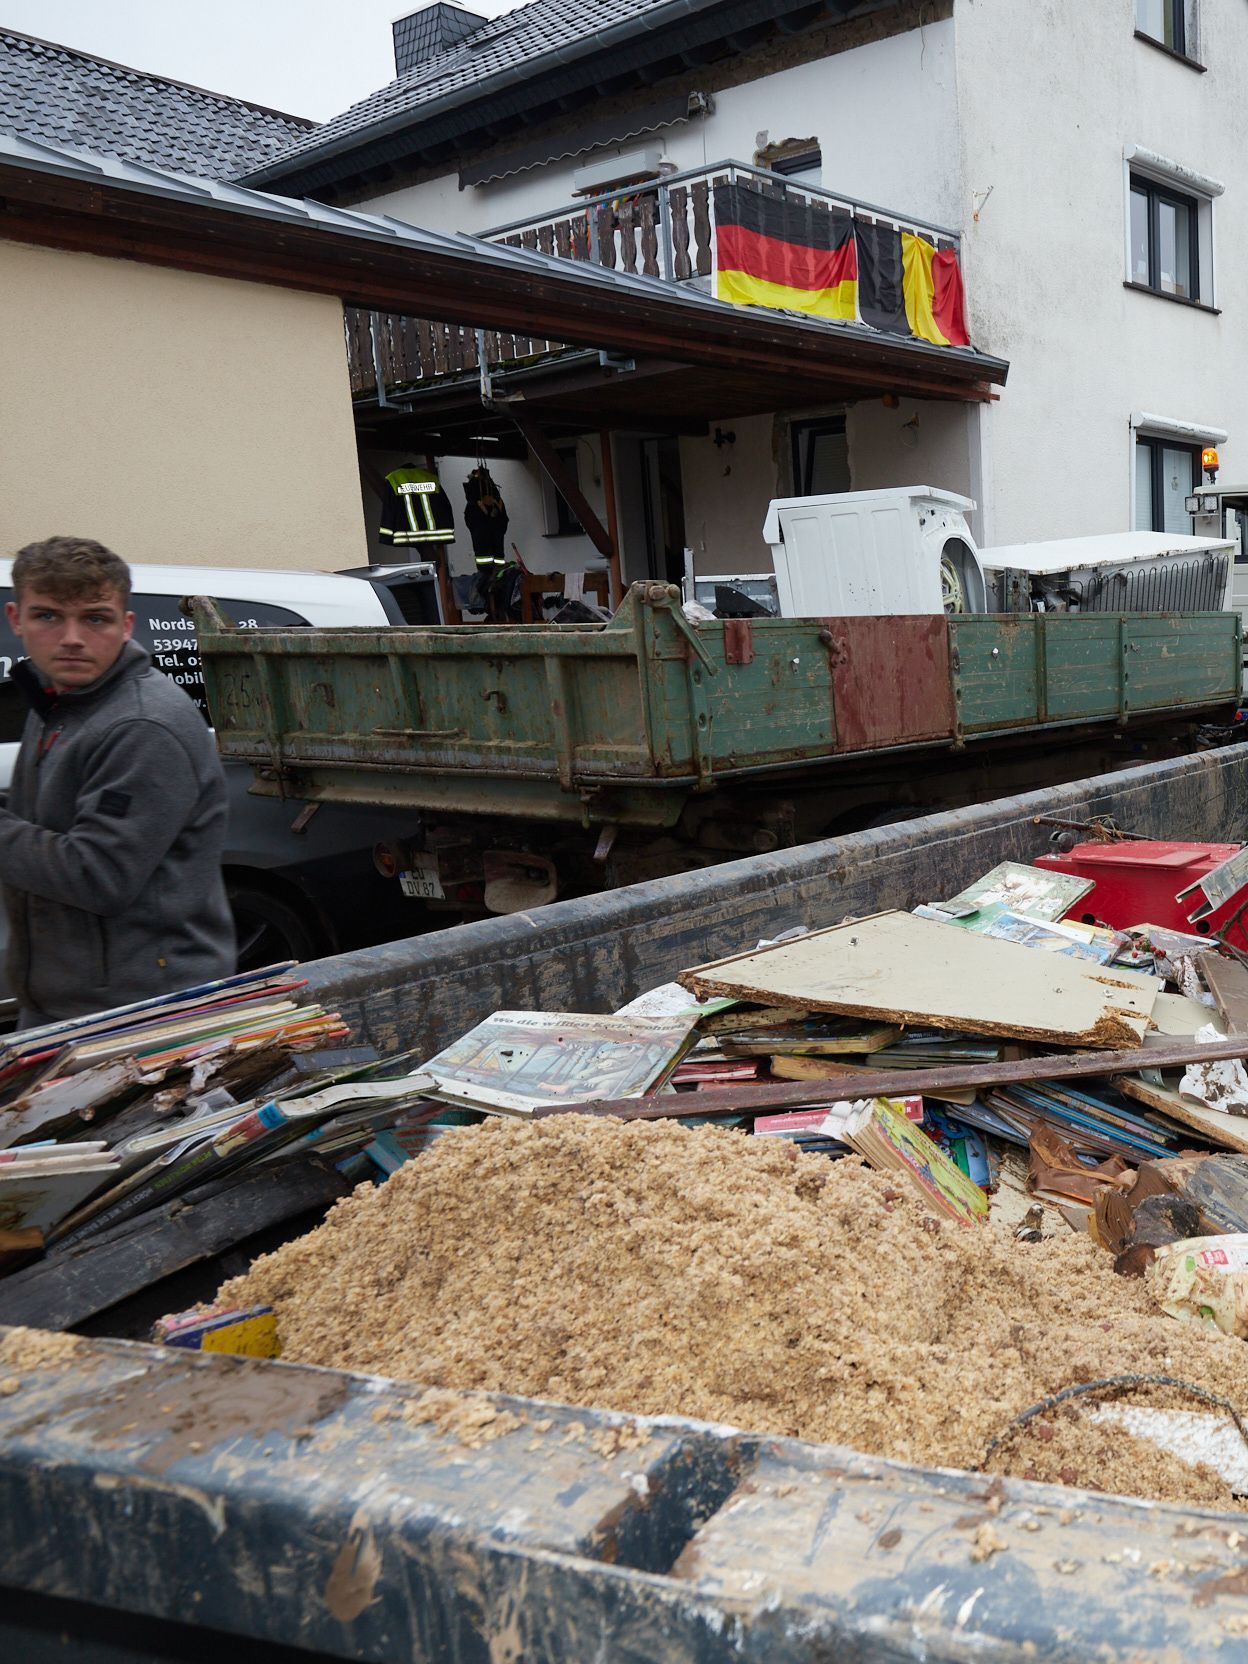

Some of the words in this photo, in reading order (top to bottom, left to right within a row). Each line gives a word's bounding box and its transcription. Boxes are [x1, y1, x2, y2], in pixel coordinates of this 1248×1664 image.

[149, 618, 195, 631] Nords
[153, 639, 198, 652] 53947
[155, 654, 184, 667] Tel.
[406, 881, 420, 895] DV
[422, 882, 435, 897] 87
